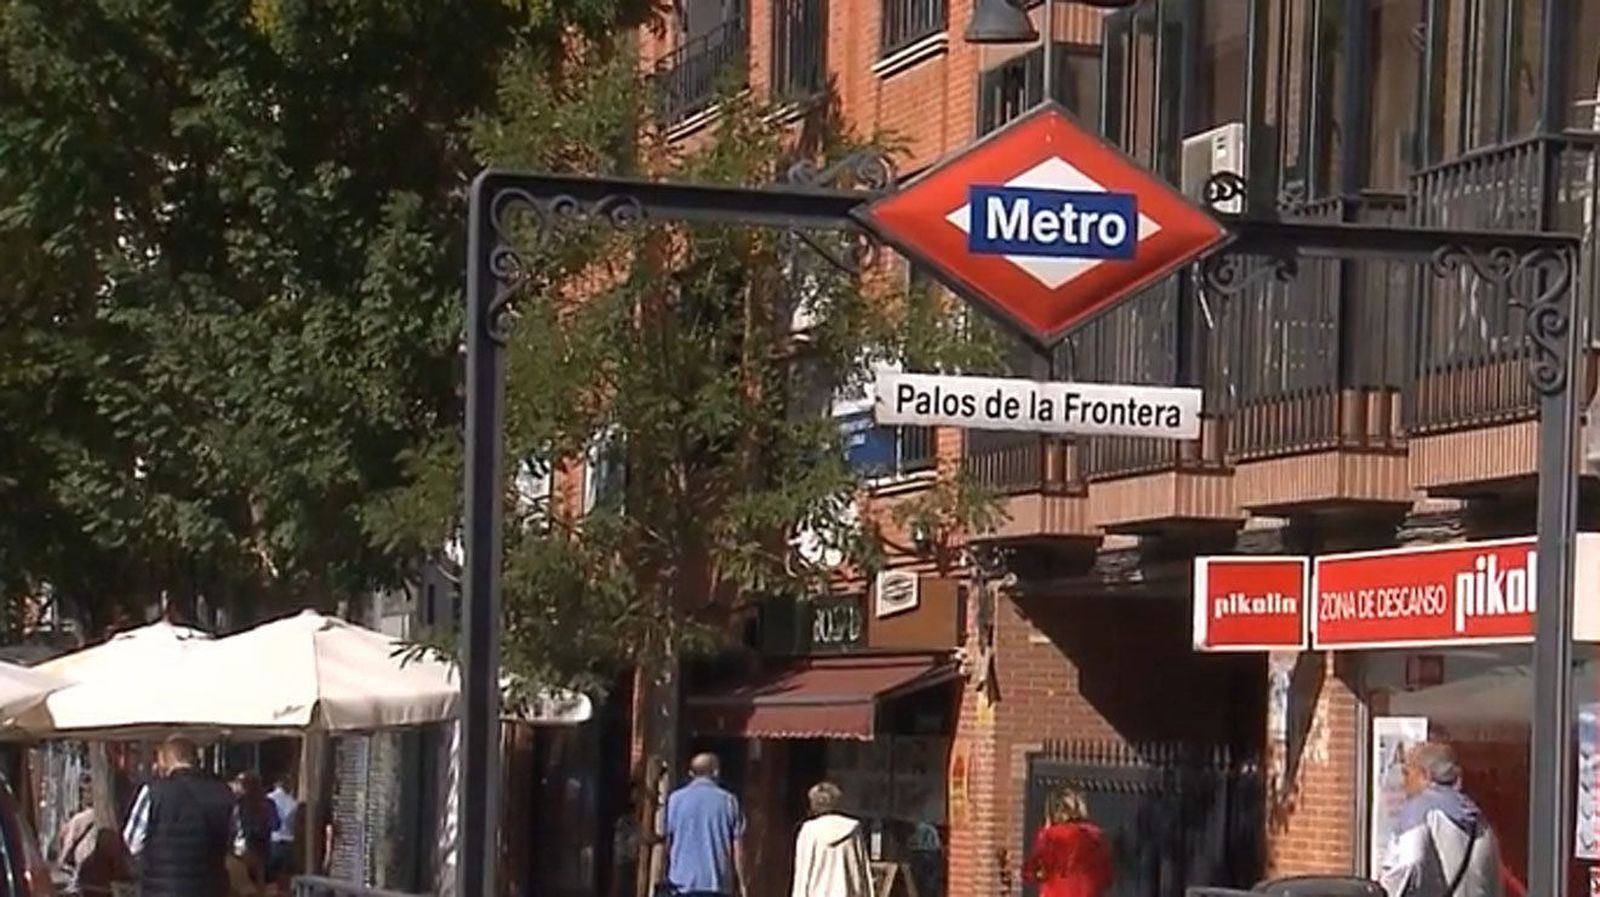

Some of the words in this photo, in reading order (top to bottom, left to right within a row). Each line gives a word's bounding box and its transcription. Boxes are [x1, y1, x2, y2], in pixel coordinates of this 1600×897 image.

[986, 196, 1126, 246] Metro
[896, 383, 976, 417] Palos
[985, 388, 1019, 420] de
[1029, 391, 1053, 422] la
[1063, 392, 1181, 428] Frontera
[1215, 592, 1297, 619] pikolin
[1320, 591, 1356, 620] ZONA
[1358, 589, 1375, 618] DE
[1377, 584, 1447, 617] DESCANSO
[1455, 551, 1537, 632] pikol
